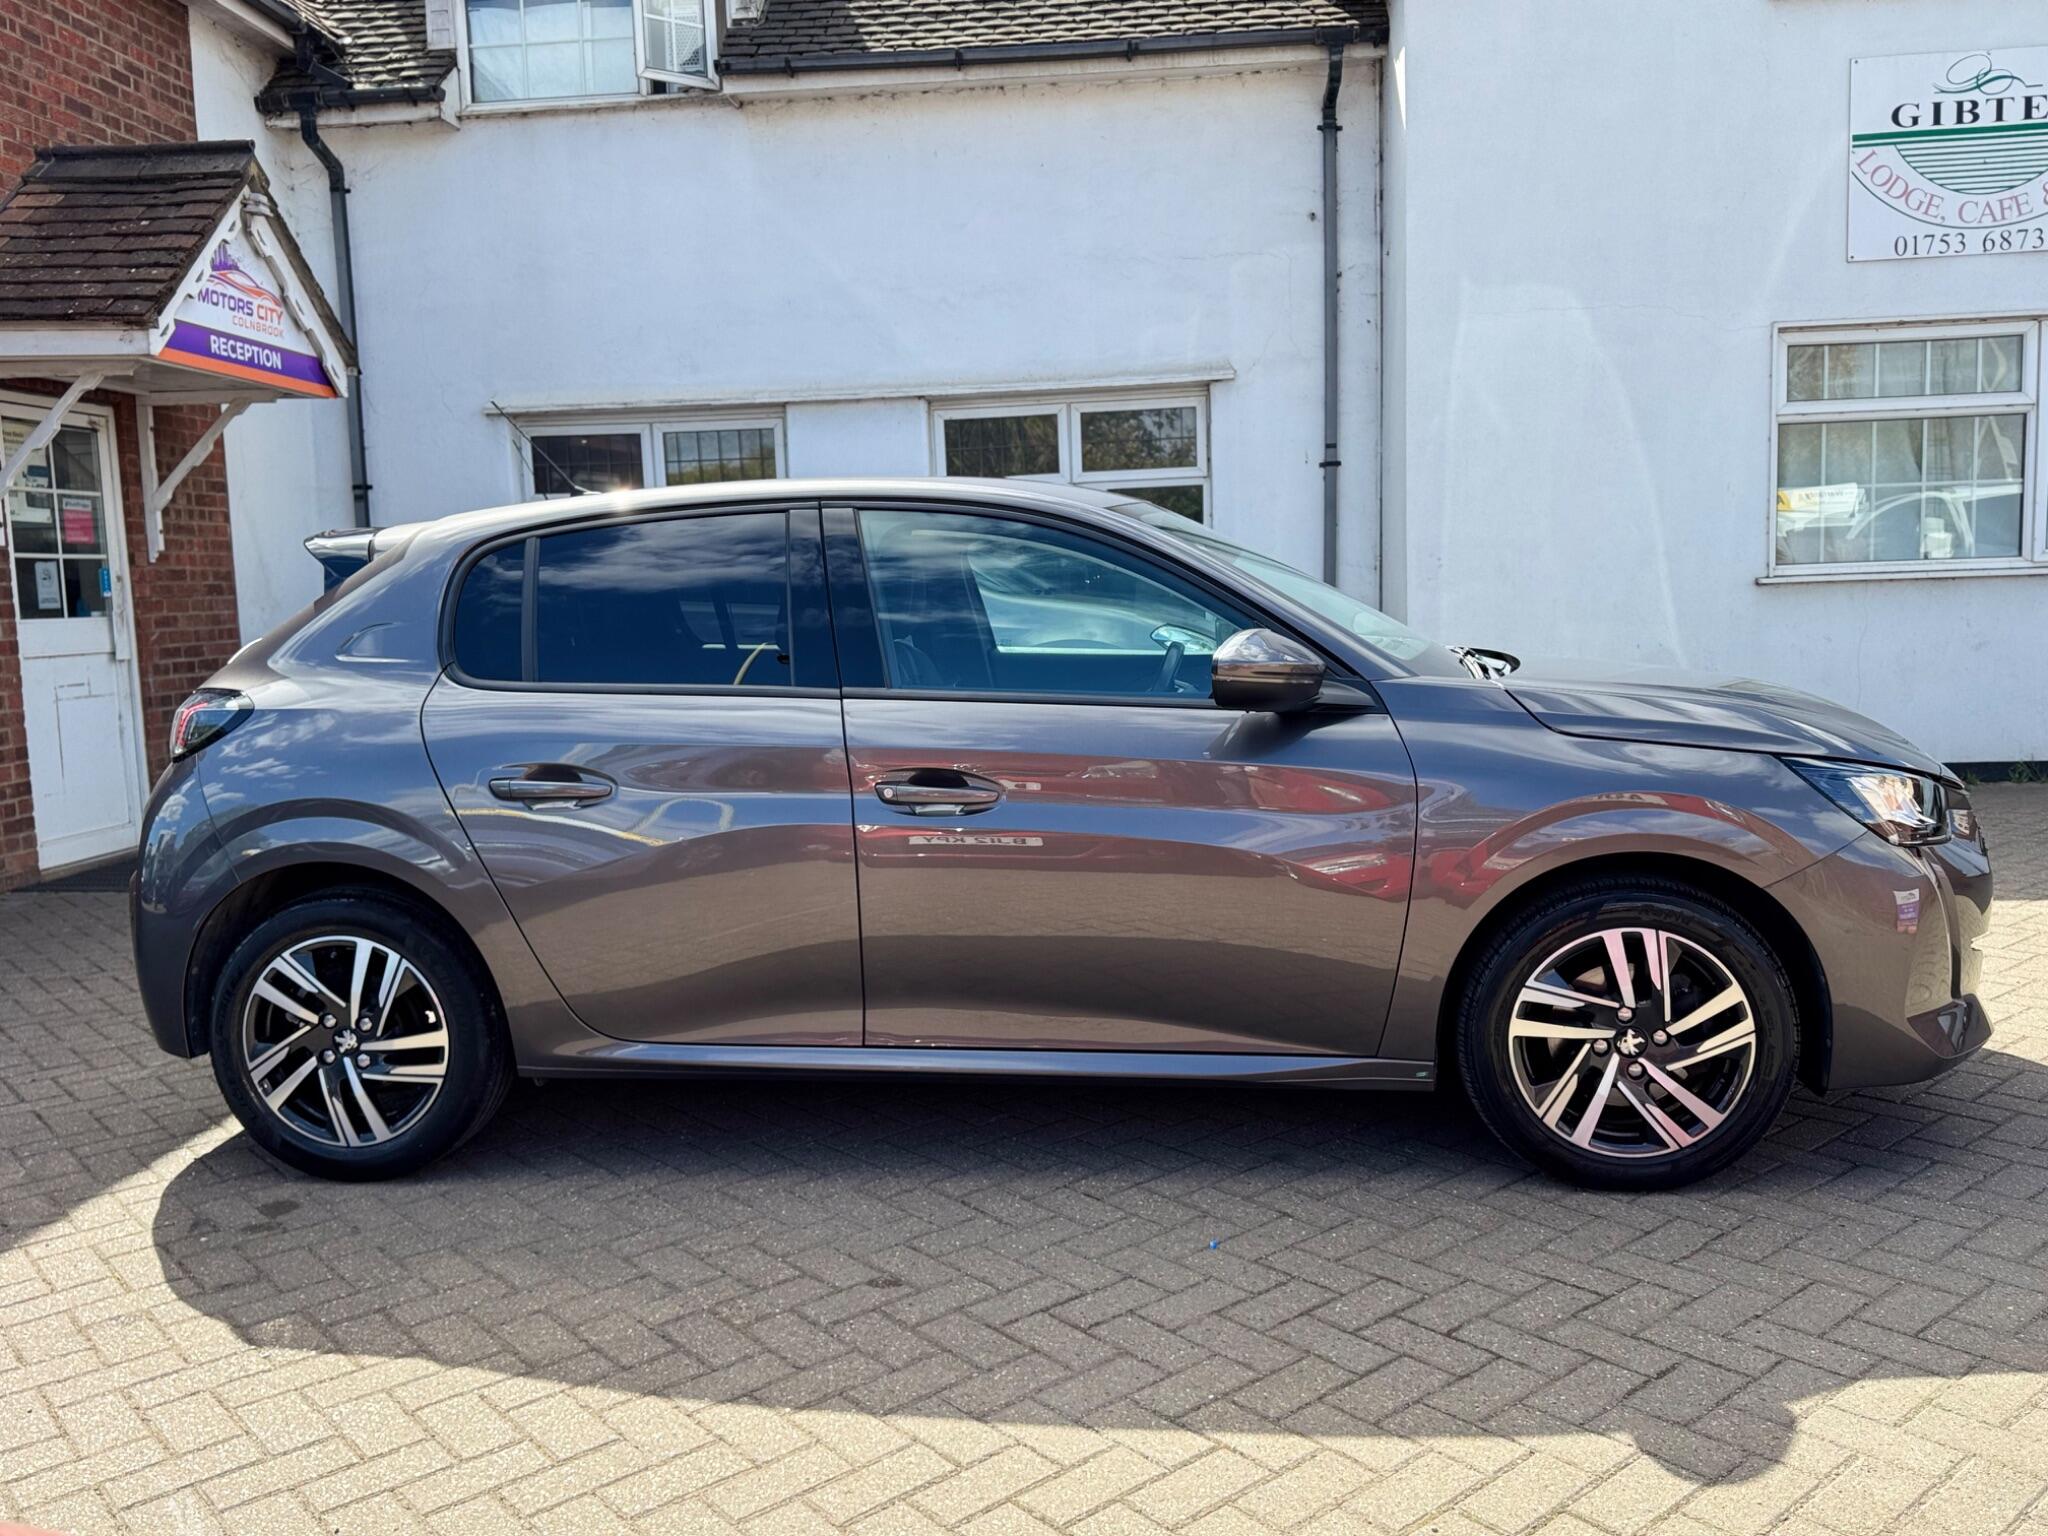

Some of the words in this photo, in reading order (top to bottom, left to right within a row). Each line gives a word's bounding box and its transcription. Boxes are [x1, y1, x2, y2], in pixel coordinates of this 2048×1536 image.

[1856, 149, 1946, 224] LODGE,
[1957, 192, 2034, 225] CAFE
[1894, 232, 1966, 257] 01753
[1982, 227, 2044, 253] 6873
[197, 287, 254, 317] MOTORS
[256, 303, 284, 326] CITY
[232, 315, 285, 338] COLNBROOK
[210, 334, 282, 370] RECEPTION
